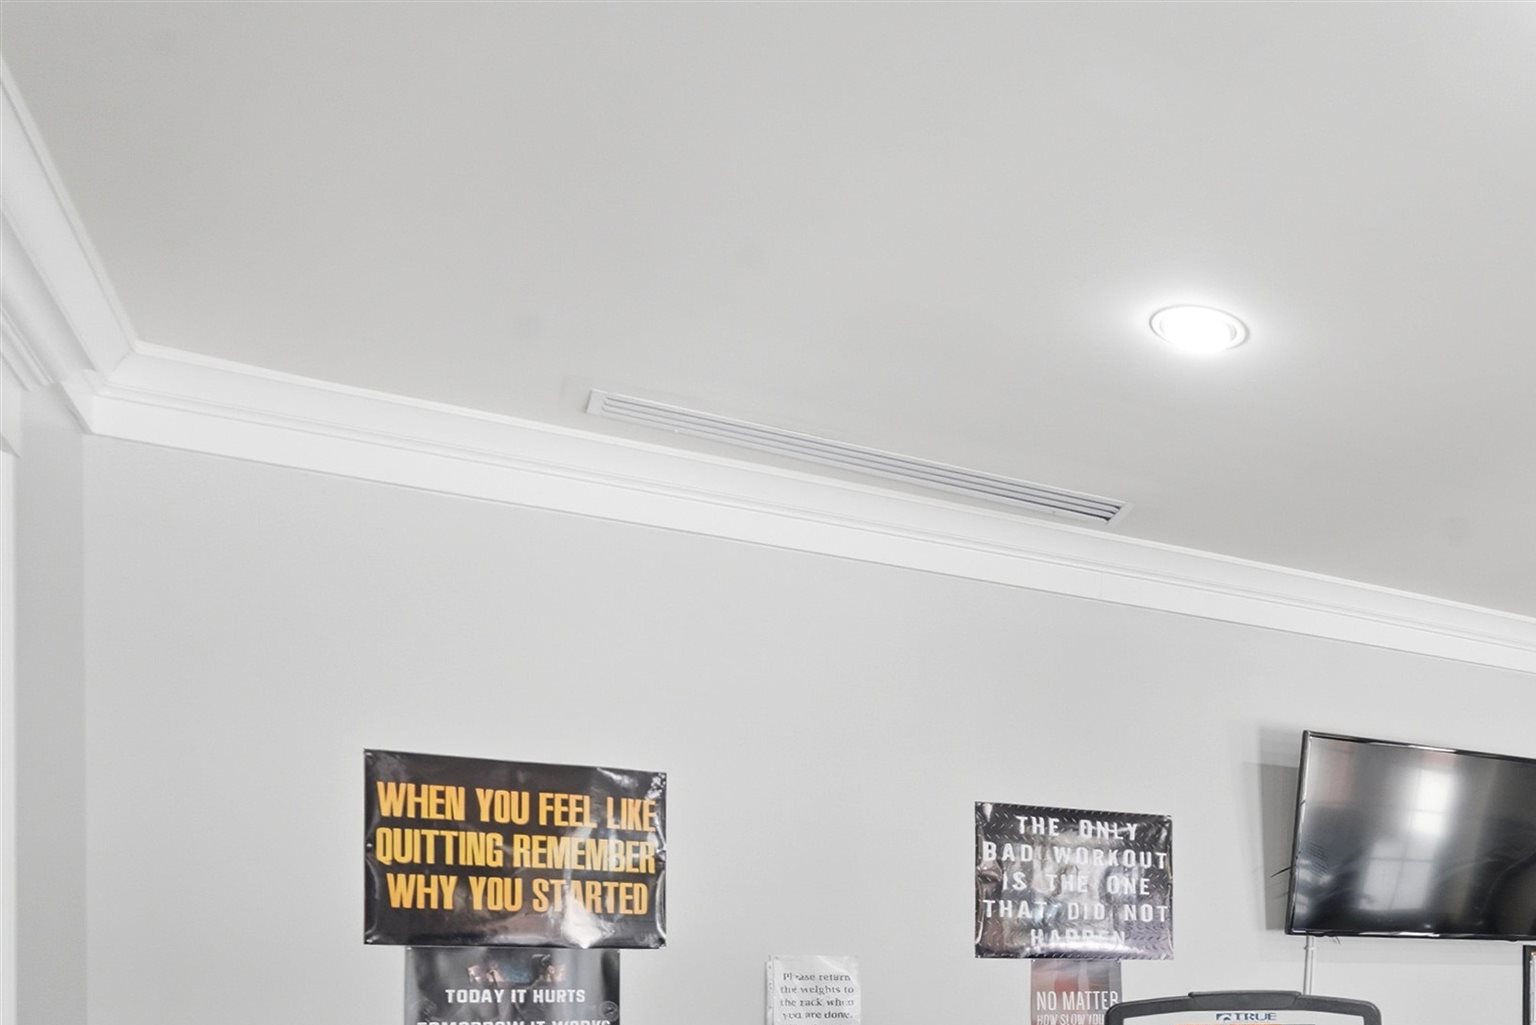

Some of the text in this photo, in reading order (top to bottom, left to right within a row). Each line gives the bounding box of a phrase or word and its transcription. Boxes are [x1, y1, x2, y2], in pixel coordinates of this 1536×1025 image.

[376, 781, 656, 832] WHEN YOU FEEL LIKE
[1015, 815, 1138, 841] THE ONLY
[375, 827, 655, 874] QUITTING REMEMBER
[982, 841, 1167, 869] BAD WORKOUT
[1002, 872, 1151, 895] IS THE ONE
[386, 873, 648, 915] WHY YOU STARTED
[983, 899, 1168, 922] THAT DID NOT
[819, 973, 851, 981] return
[445, 989, 585, 1003] TODAY IT HURTS
[780, 985, 855, 995] the weights to
[1036, 990, 1120, 1010] NO MATTER
[780, 998, 797, 1006] the
[800, 998, 823, 1006] rack
[805, 1011, 821, 1019] are
[1037, 1013, 1058, 1025] HOW
[1060, 1013, 1085, 1025] SLOW
[1235, 1012, 1277, 1021] TRUE
